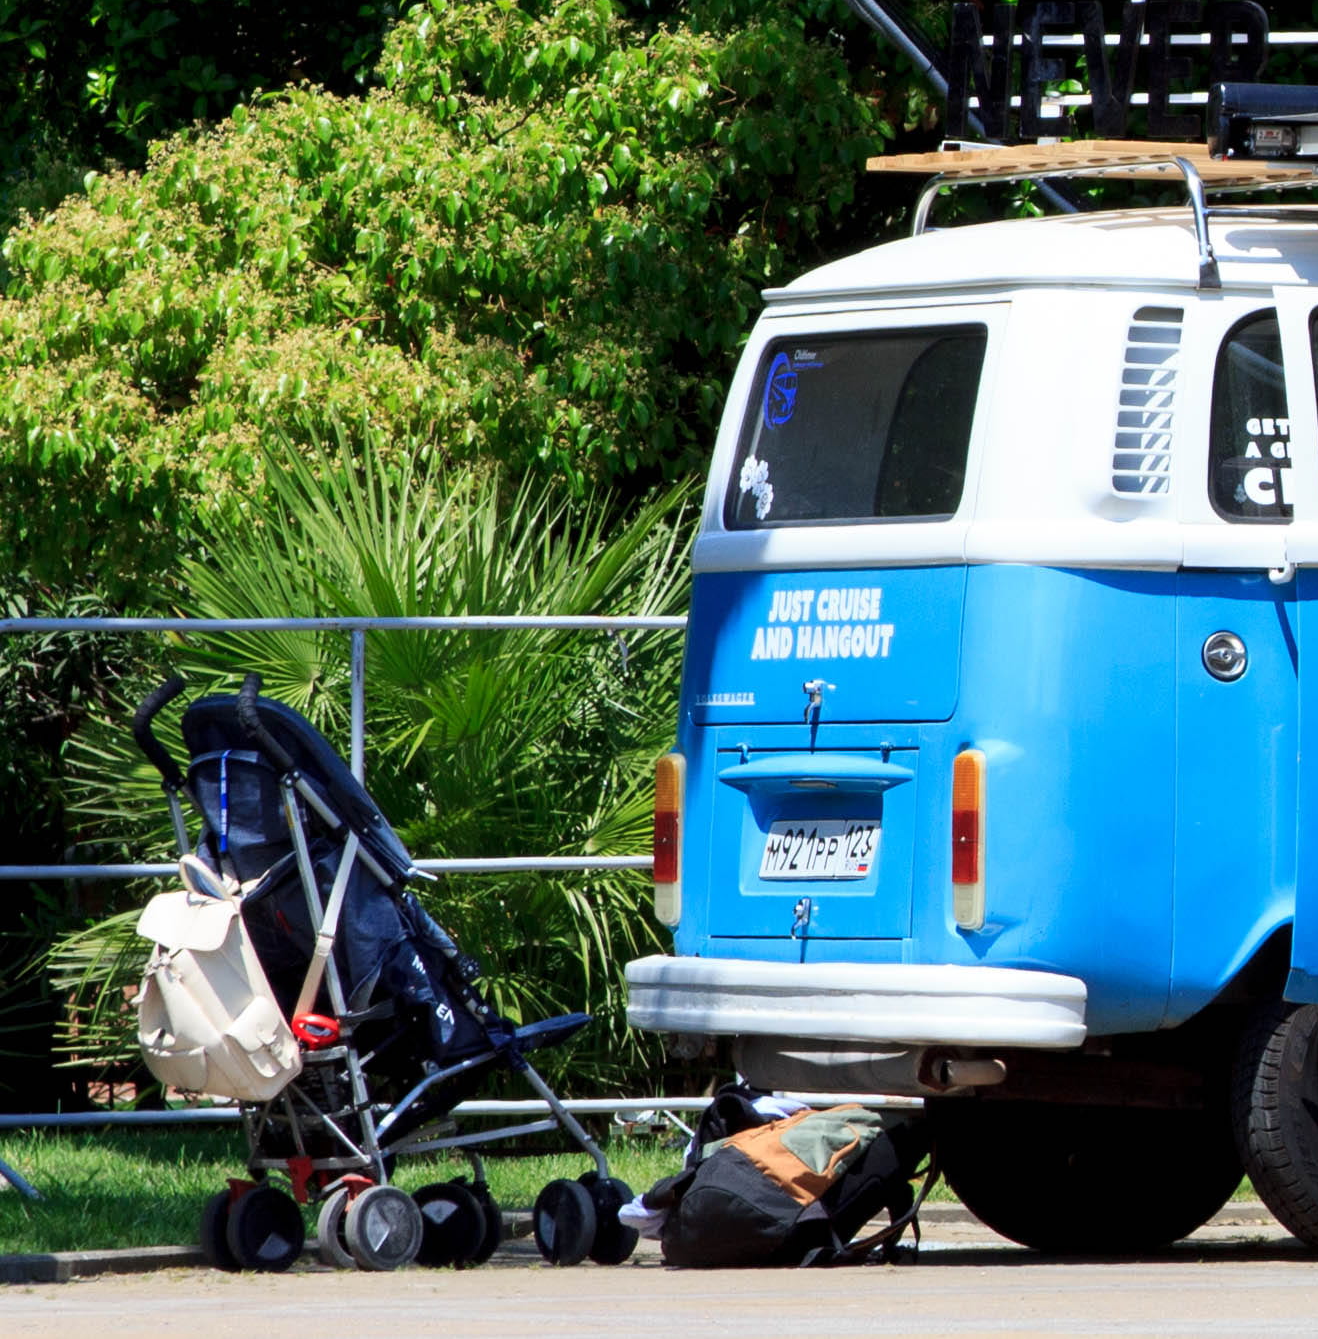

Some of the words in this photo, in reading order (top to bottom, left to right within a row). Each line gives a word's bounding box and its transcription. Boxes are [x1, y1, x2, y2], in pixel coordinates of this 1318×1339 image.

[943, 0, 1271, 142] NEVER
[1245, 418, 1290, 436] GET
[1244, 441, 1262, 459] A
[768, 589, 816, 623] JUST
[816, 587, 883, 622] CRUISE
[751, 626, 794, 660] AND
[795, 624, 895, 659] HANGOUT
[845, 824, 876, 859] 123
